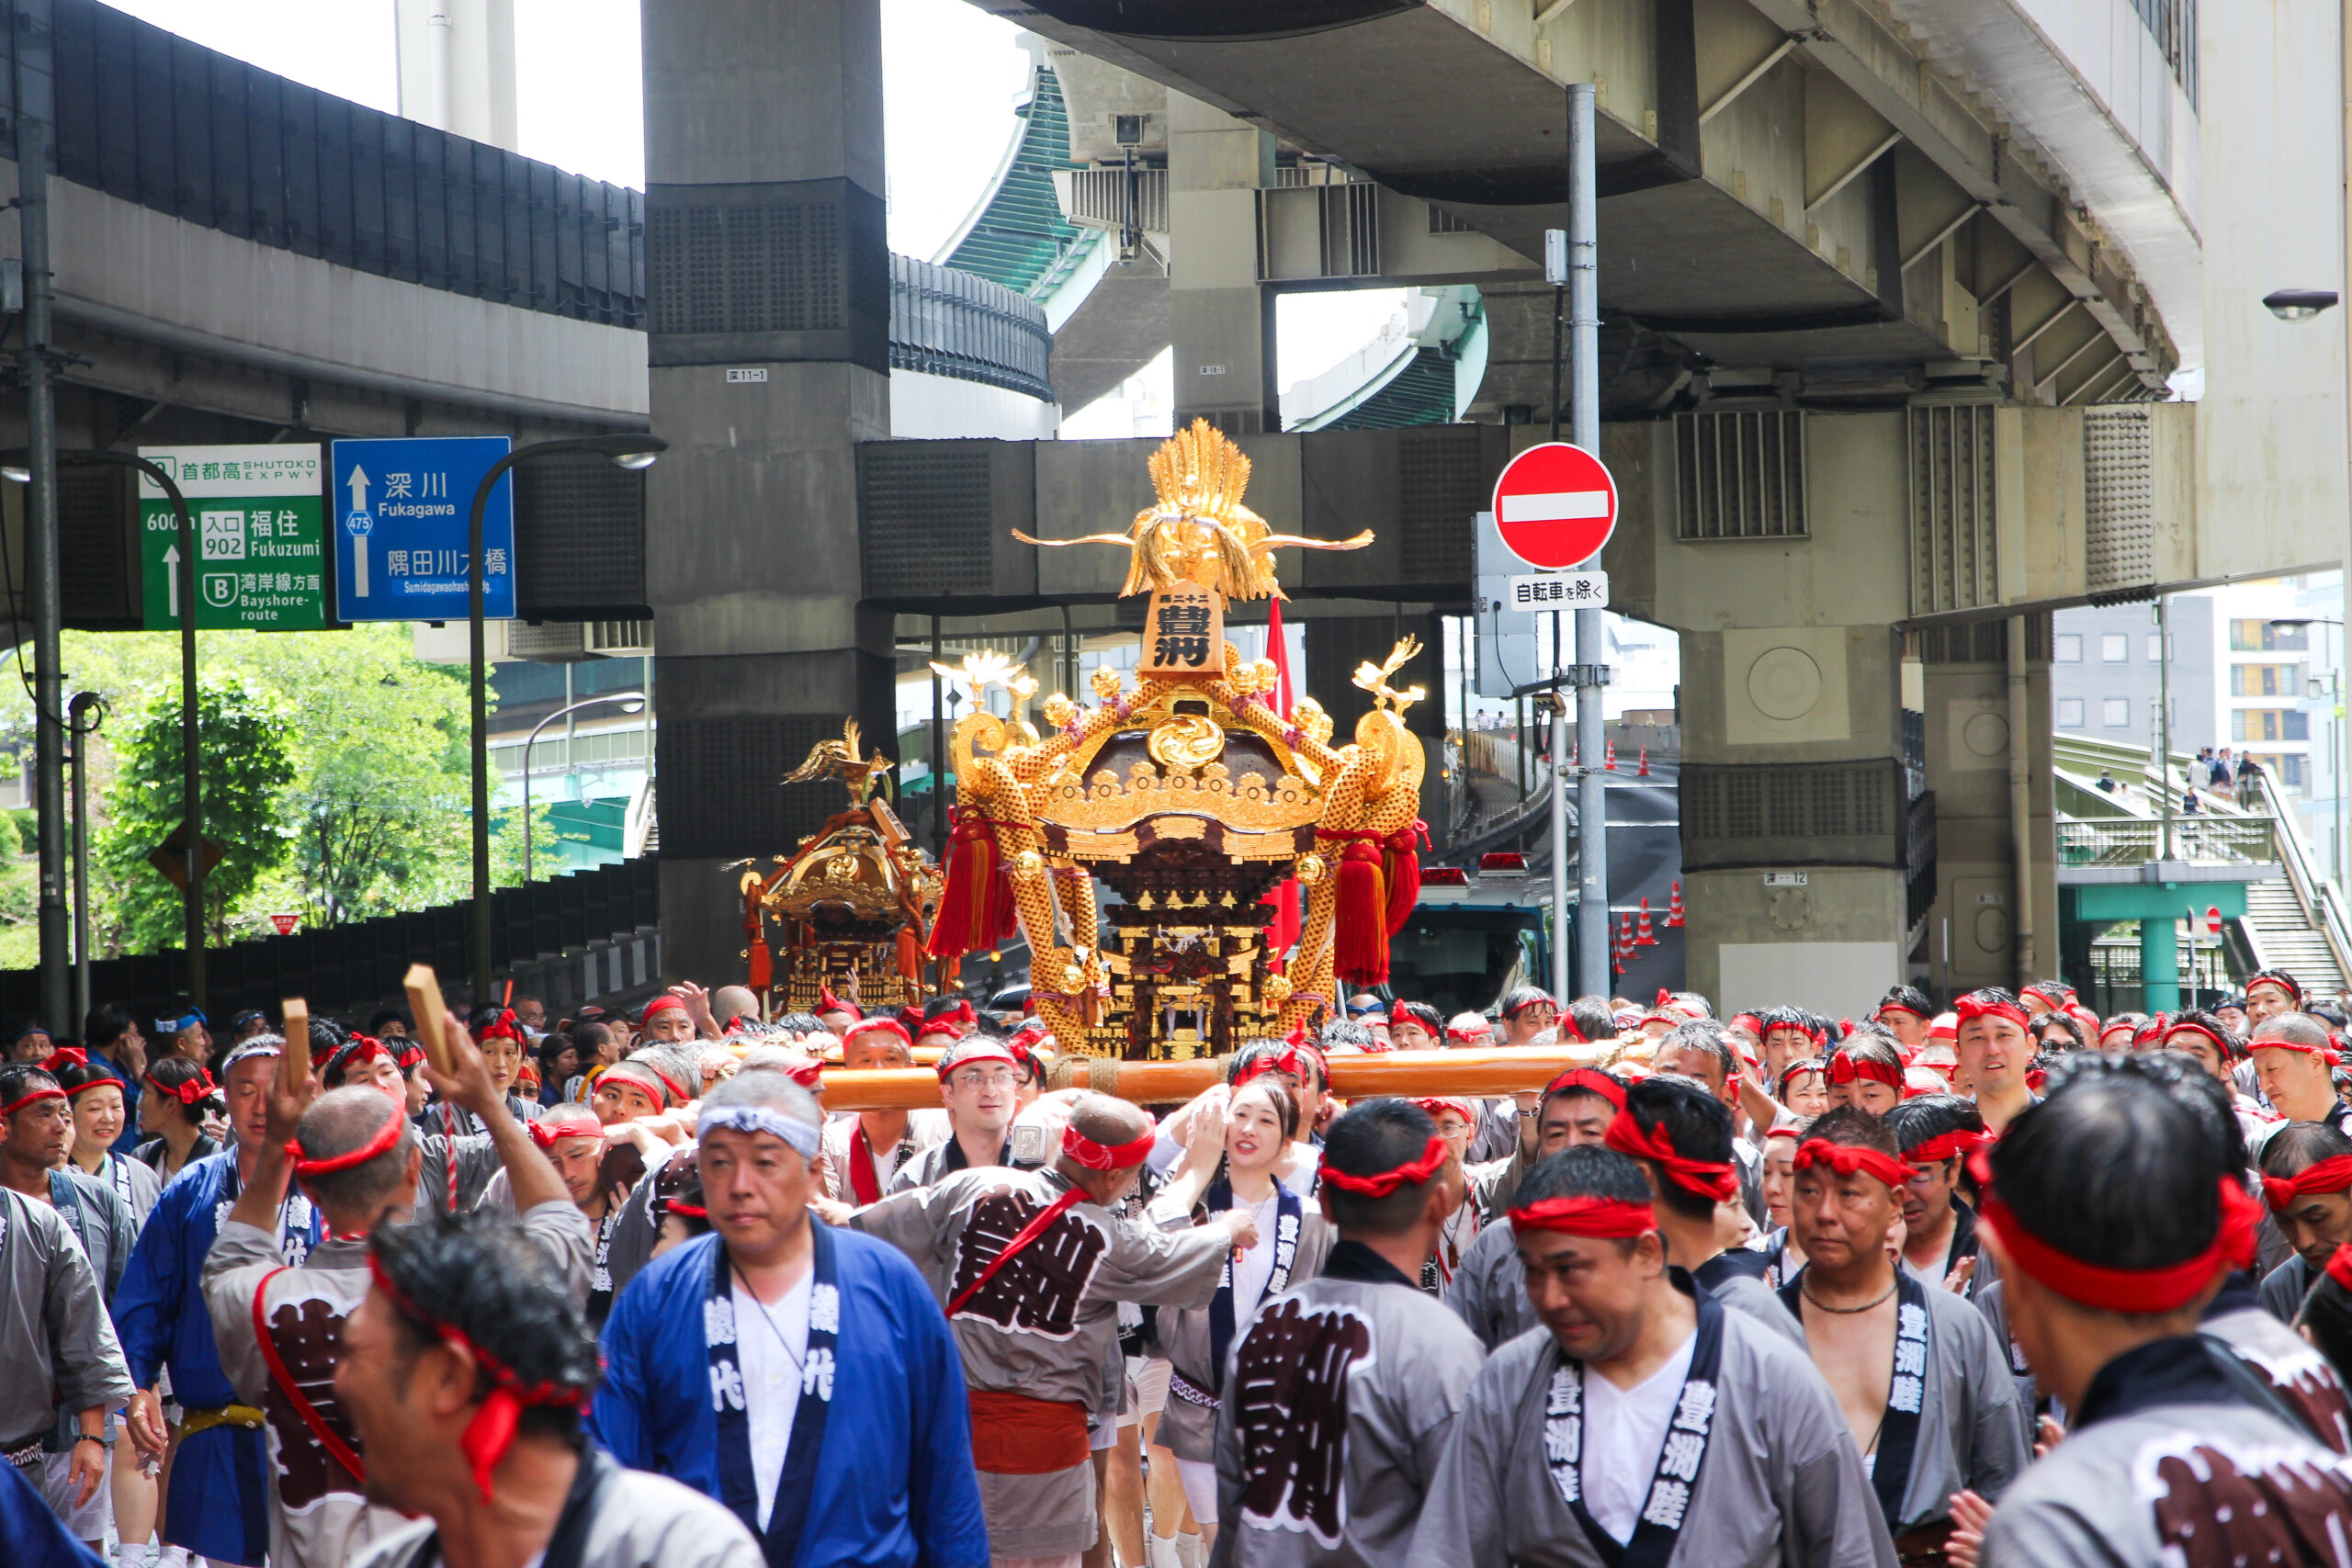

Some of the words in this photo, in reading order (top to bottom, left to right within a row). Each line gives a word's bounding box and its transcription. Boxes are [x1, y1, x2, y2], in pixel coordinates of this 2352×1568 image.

[182, 462, 241, 480] 首都高
[243, 460, 316, 469] SHUTOKO
[244, 471, 314, 479] EXPWY
[385, 472, 447, 499] 深川
[379, 502, 455, 518] Fukagawa
[206, 516, 240, 533] 入口
[250, 510, 300, 537] 福住
[349, 517, 369, 530] 475
[206, 538, 242, 555] 902
[251, 539, 320, 557] Fukuzumi
[214, 579, 229, 599] B
[241, 572, 320, 592] 湾岸線方面
[404, 581, 469, 594] Sumidagawaohash
[1517, 580, 1601, 603] 自転車を除く
[241, 595, 309, 609] Bayshore-
[242, 610, 278, 620] route
